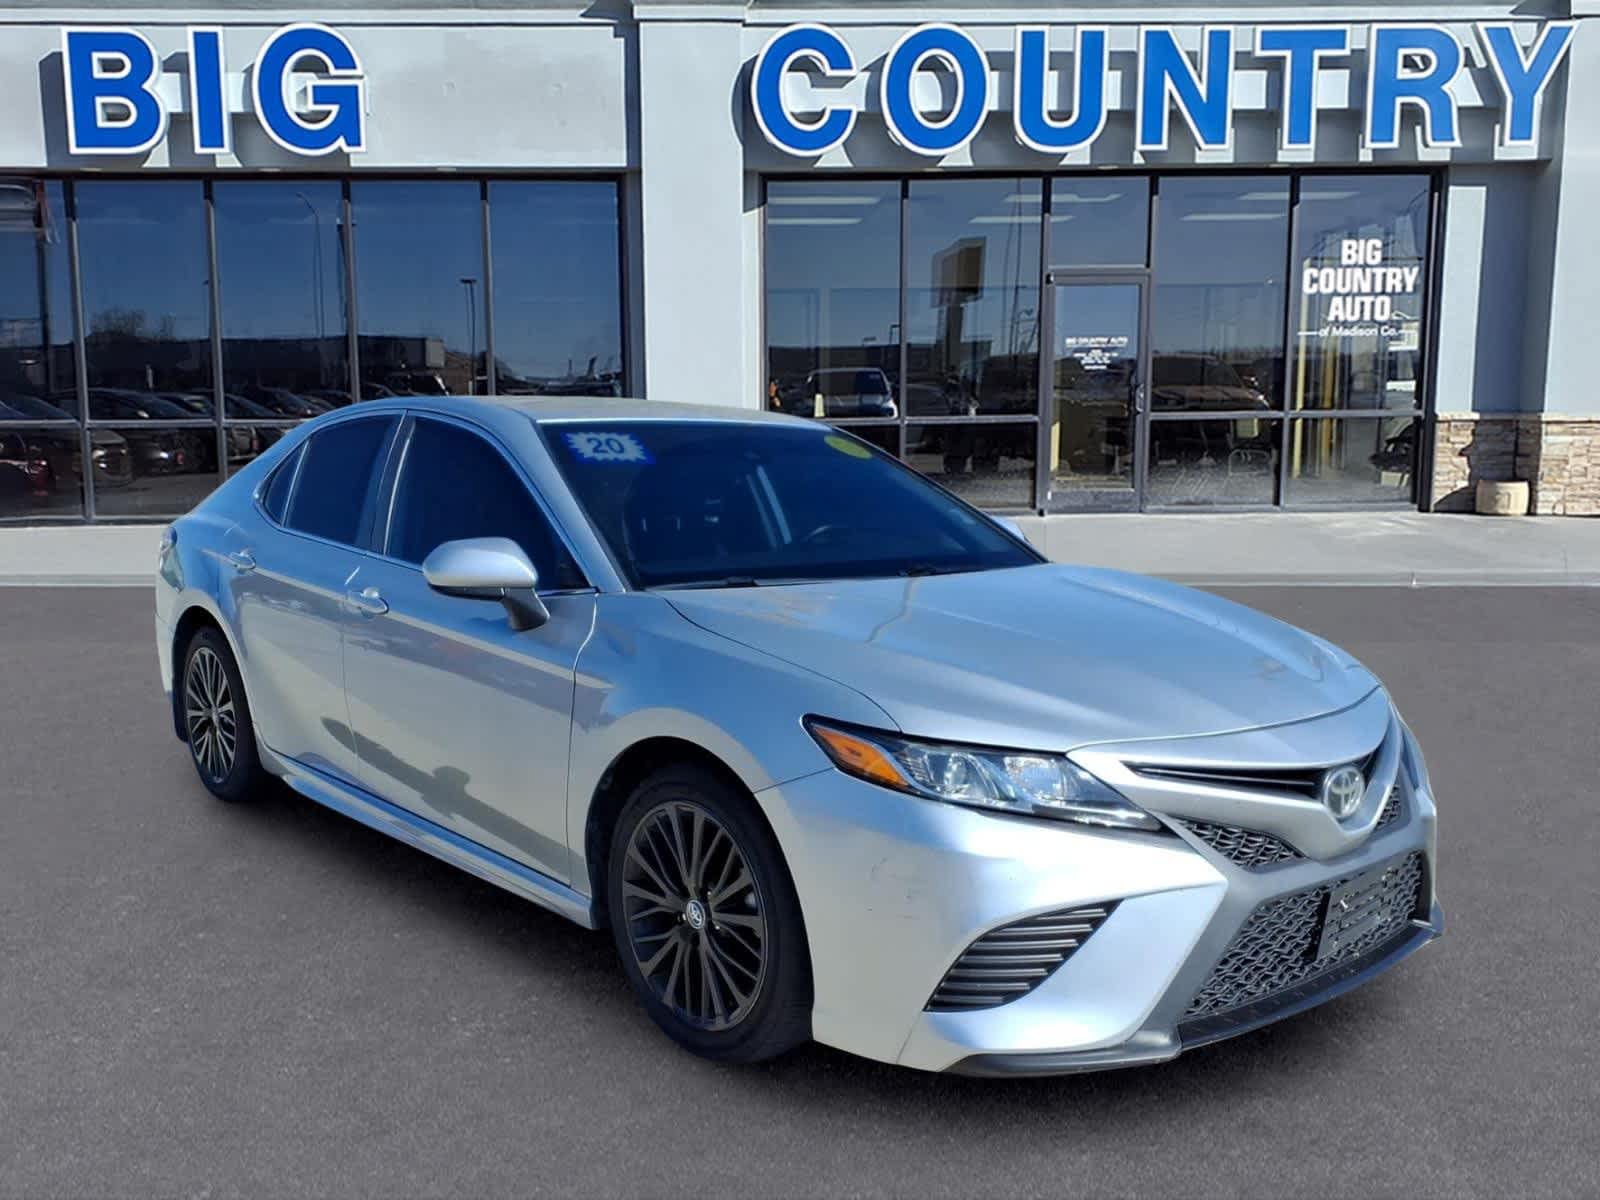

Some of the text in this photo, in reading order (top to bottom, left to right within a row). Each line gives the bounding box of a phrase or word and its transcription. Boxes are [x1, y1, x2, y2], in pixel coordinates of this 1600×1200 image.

[61, 22, 1575, 156] BIG COUNTRY
[1341, 238, 1382, 265] BIG
[1303, 266, 1419, 294] COUNTRY
[1328, 296, 1391, 322] AUTO
[1319, 325, 1330, 337] of
[1331, 325, 1378, 337] Madison
[586, 437, 624, 454] 20
